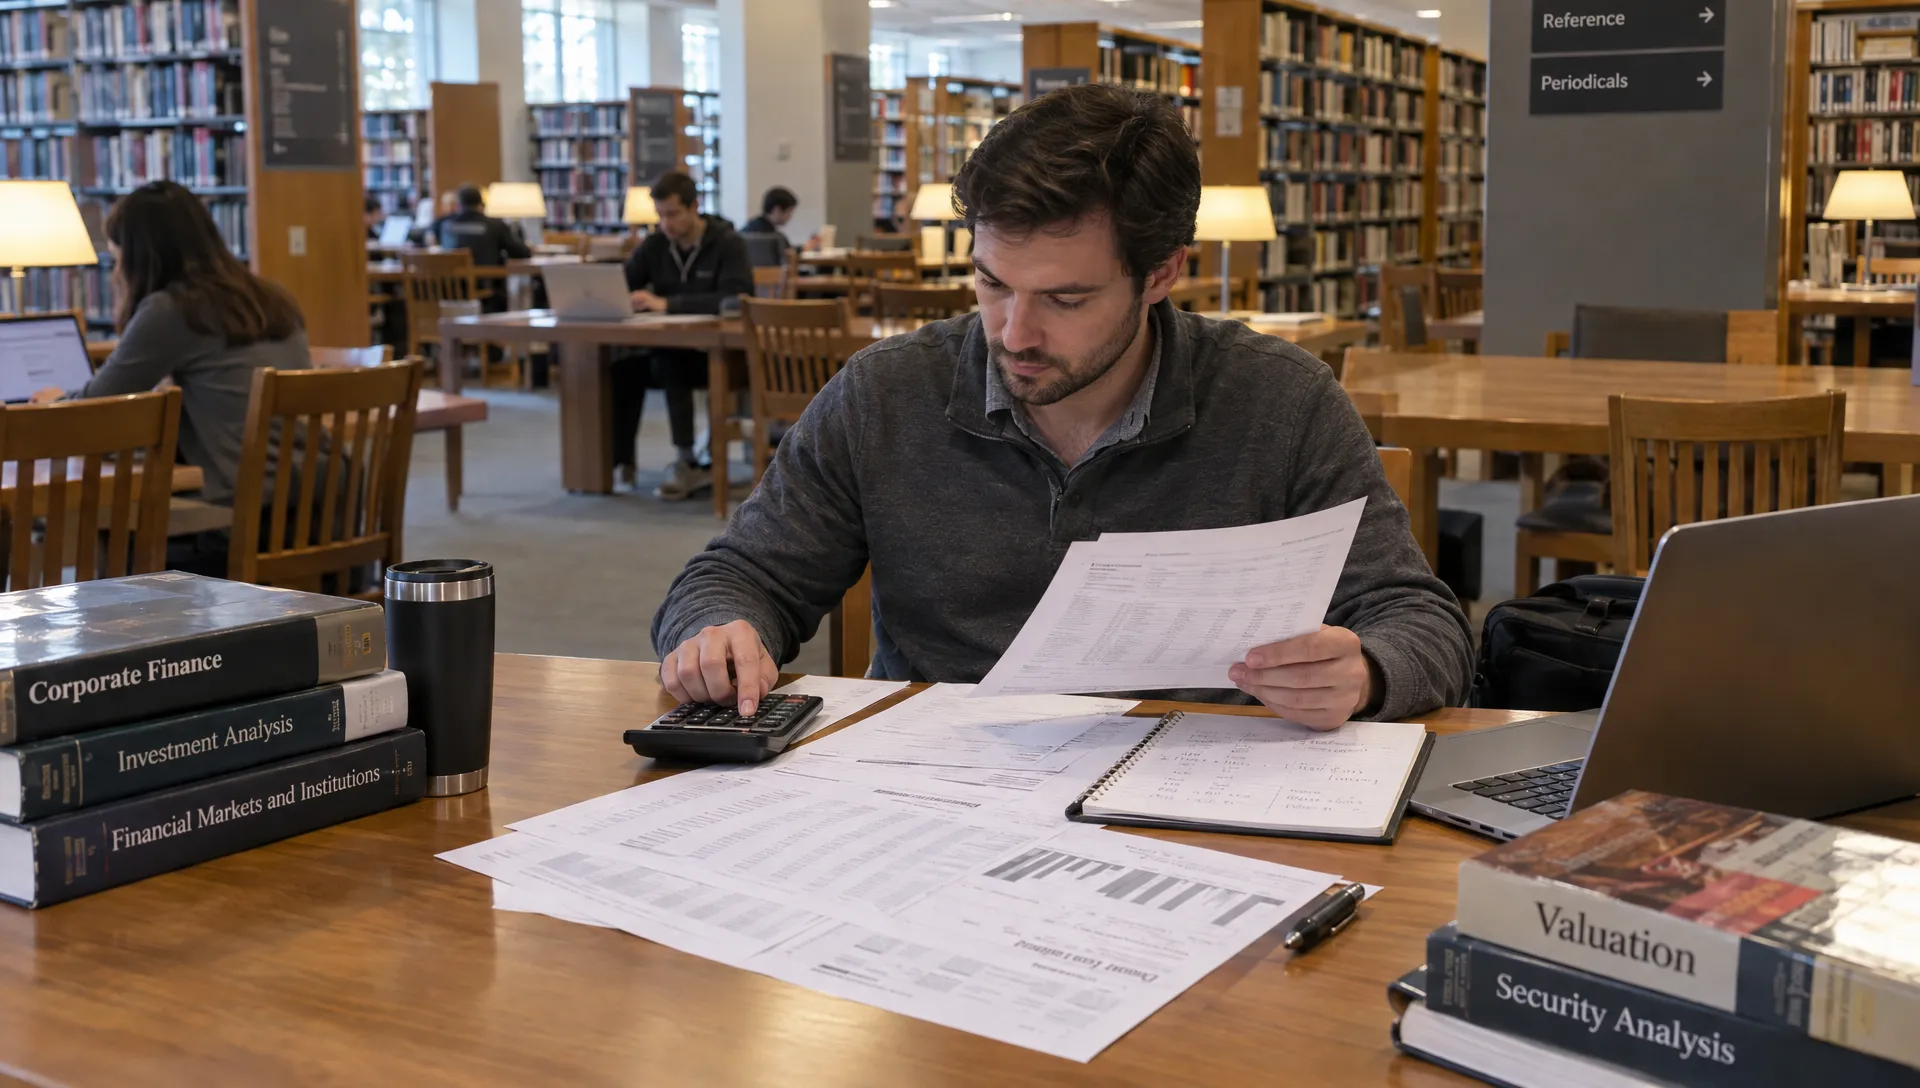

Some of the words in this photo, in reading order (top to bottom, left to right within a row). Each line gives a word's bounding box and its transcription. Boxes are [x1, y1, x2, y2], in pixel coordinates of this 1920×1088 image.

[1543, 12, 1625, 28] Reference
[1541, 72, 1628, 90] Periodicals
[29, 667, 141, 704] Corporate
[147, 653, 222, 682] Finance
[118, 732, 218, 772] Investment
[223, 715, 293, 747] Analysis
[111, 811, 191, 851] Financial
[198, 798, 262, 828] Markets
[267, 785, 295, 809] and
[300, 767, 380, 802] Institutions
[1535, 901, 1696, 975] Valuation
[1496, 973, 1607, 1032] Security
[1614, 1007, 1735, 1064] Analysis
